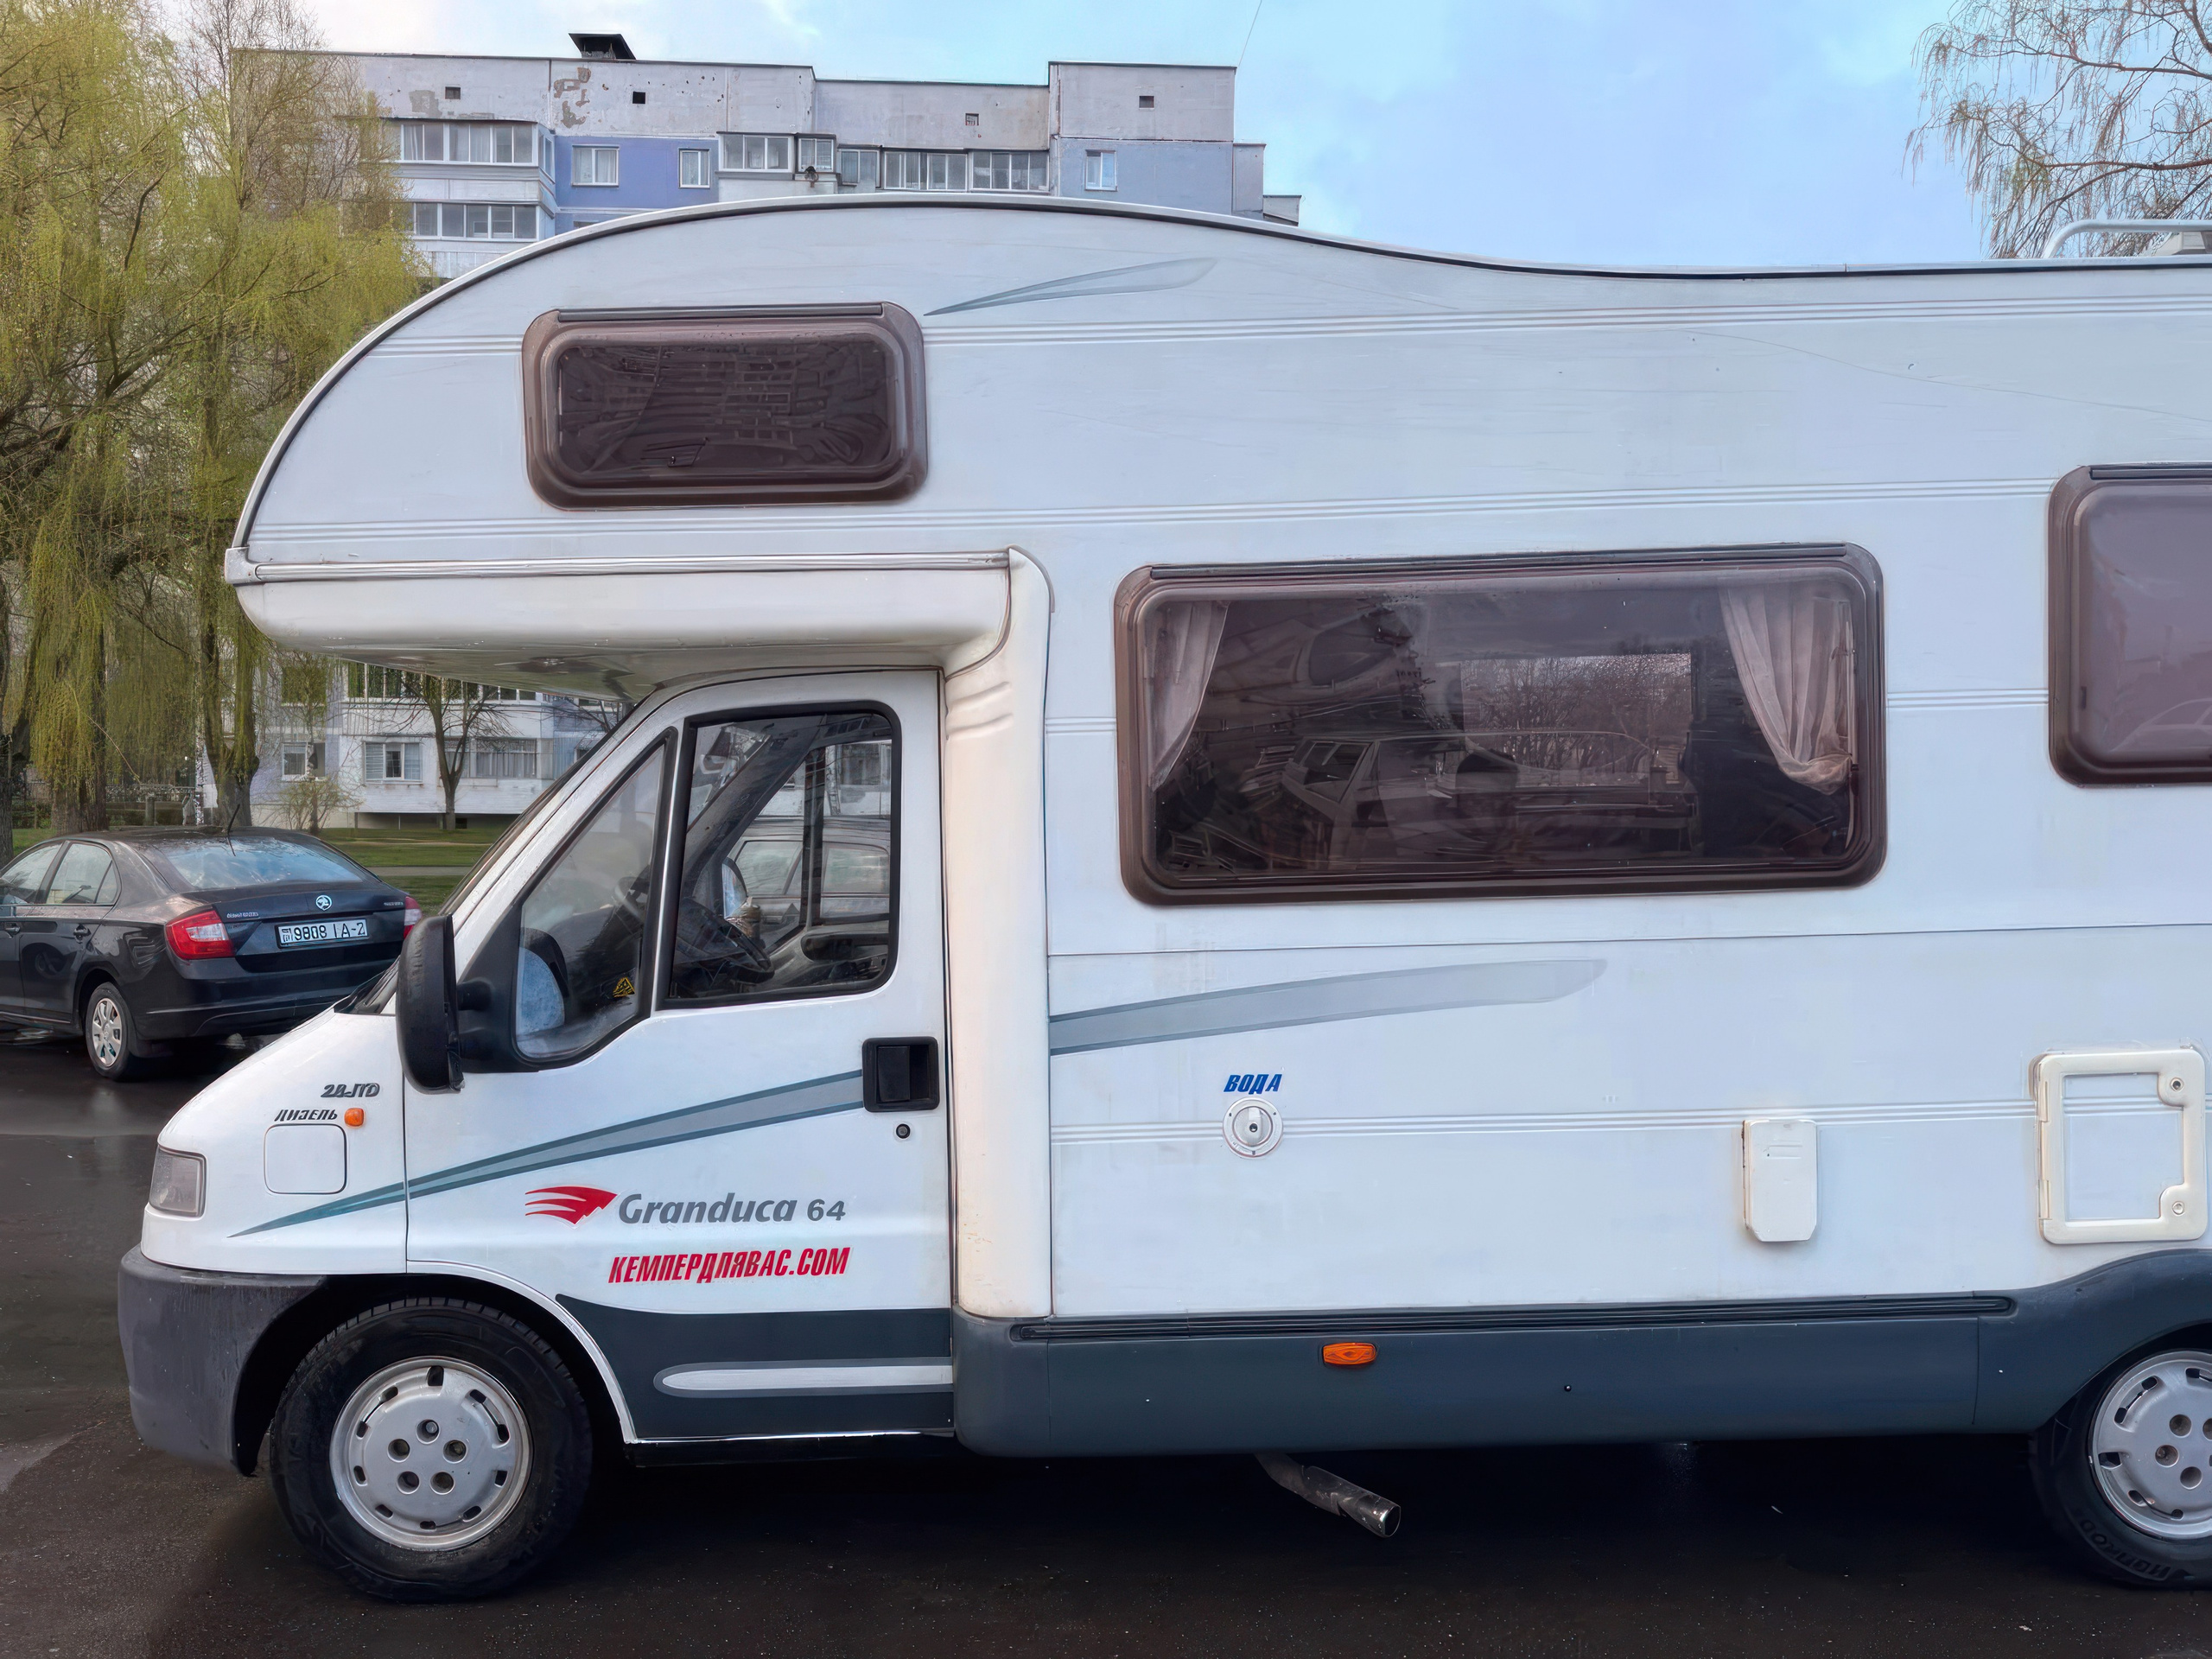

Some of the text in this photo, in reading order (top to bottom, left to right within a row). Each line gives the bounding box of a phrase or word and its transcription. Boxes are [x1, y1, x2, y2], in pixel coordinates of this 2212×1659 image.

[1223, 1073, 1283, 1095] ВОДА
[273, 1109, 339, 1122] ДИЗЕЛЬ
[618, 1192, 847, 1224] Granduca 64
